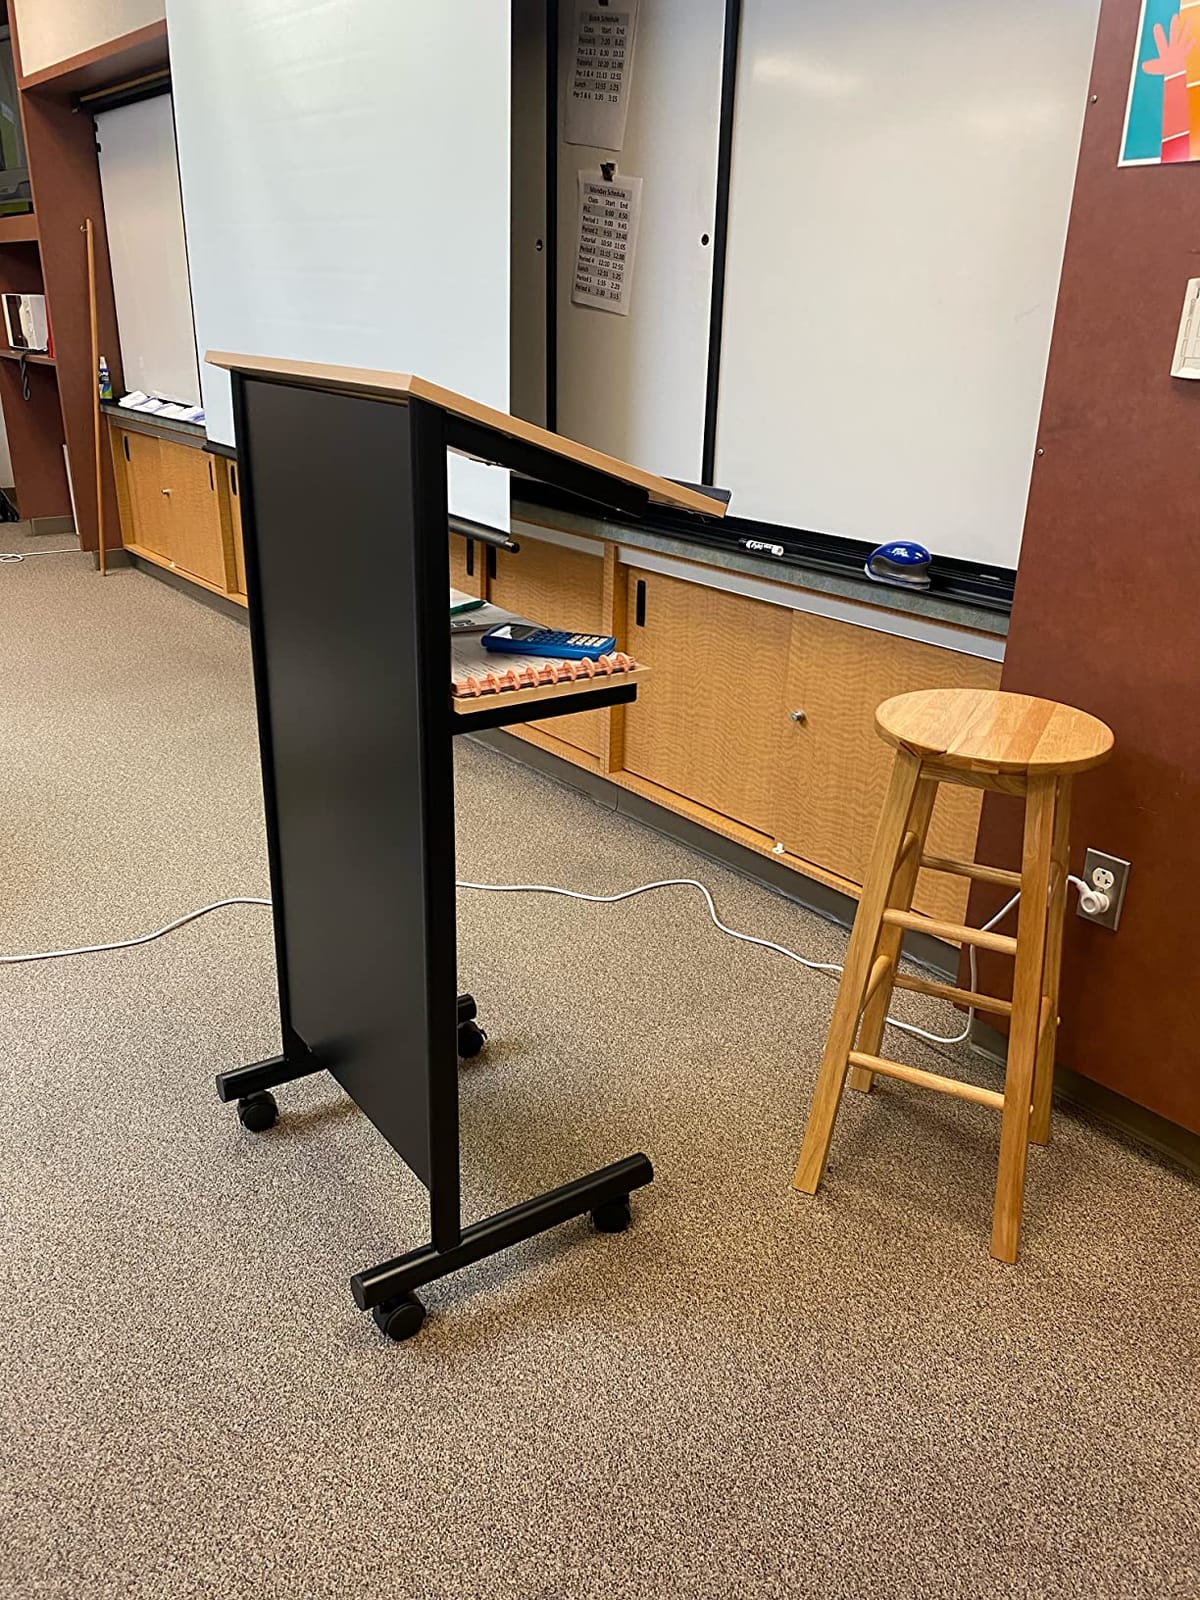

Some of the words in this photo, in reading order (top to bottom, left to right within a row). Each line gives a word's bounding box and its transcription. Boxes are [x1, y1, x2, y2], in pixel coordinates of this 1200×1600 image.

[605, 199, 615, 208] Start
[620, 201, 628, 210] End
[583, 216, 596, 224] Period
[582, 225, 595, 234] Period
[580, 245, 592, 254] Period
[579, 254, 591, 263] Period
[576, 273, 588, 282] Period
